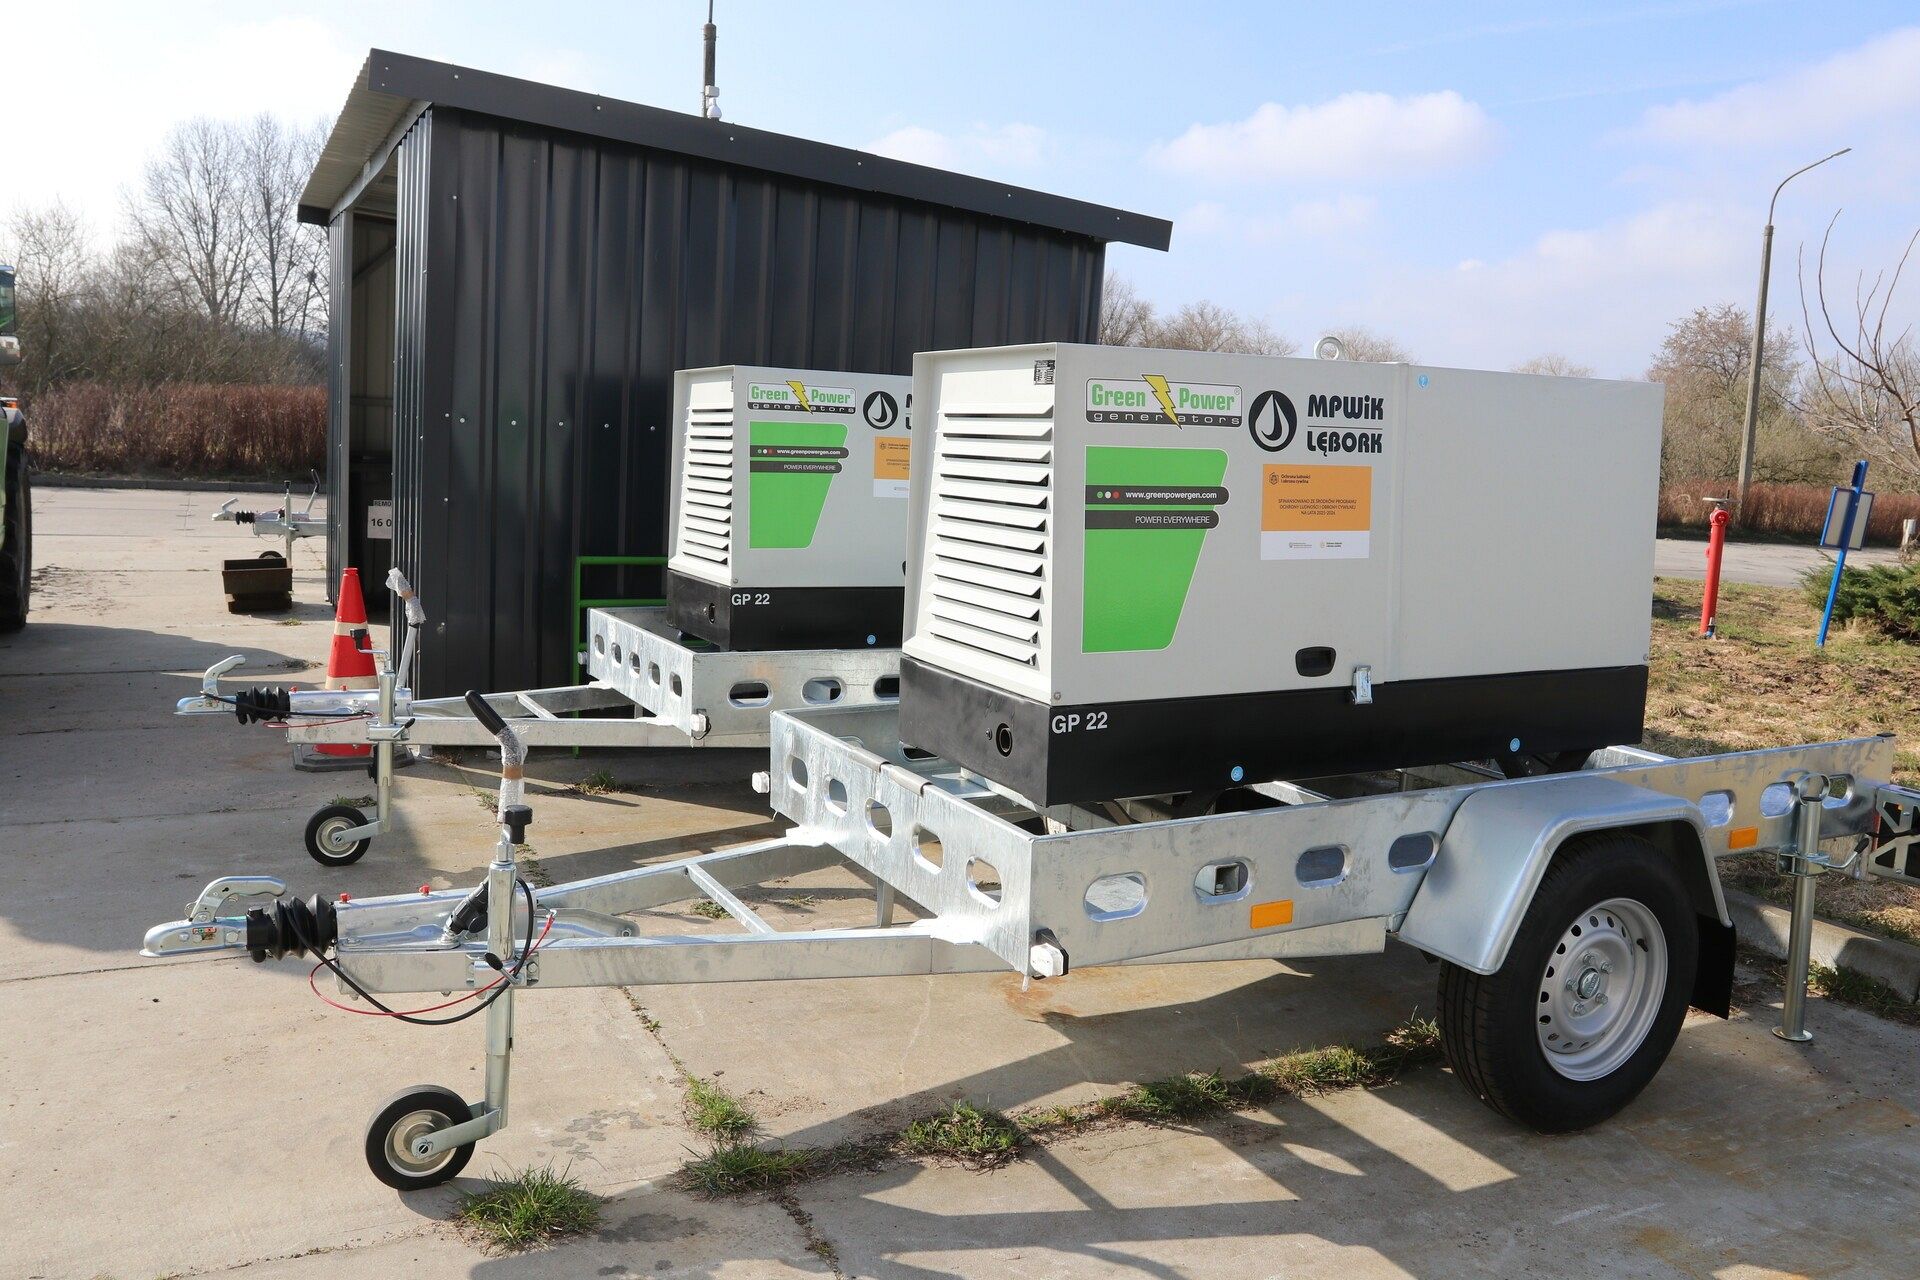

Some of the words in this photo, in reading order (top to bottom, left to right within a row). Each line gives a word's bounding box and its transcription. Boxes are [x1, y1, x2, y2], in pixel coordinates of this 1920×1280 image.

[752, 386, 788, 401] Green
[811, 389, 851, 404] Power
[1091, 384, 1146, 407] Green
[1179, 387, 1235, 411] Power
[752, 403, 855, 413] generators
[1307, 394, 1384, 420] MPWiK
[1093, 411, 1240, 425] generators
[1307, 431, 1383, 457] LĘBORK
[1125, 491, 1217, 500] www.greenpowergen.com
[371, 518, 383, 527] 16
[1135, 516, 1162, 524] POWER
[1163, 516, 1210, 524] EVERYWHERE
[731, 593, 751, 606] GP
[754, 593, 770, 605] 22
[1052, 713, 1081, 734] GP
[1086, 711, 1108, 730] 22
